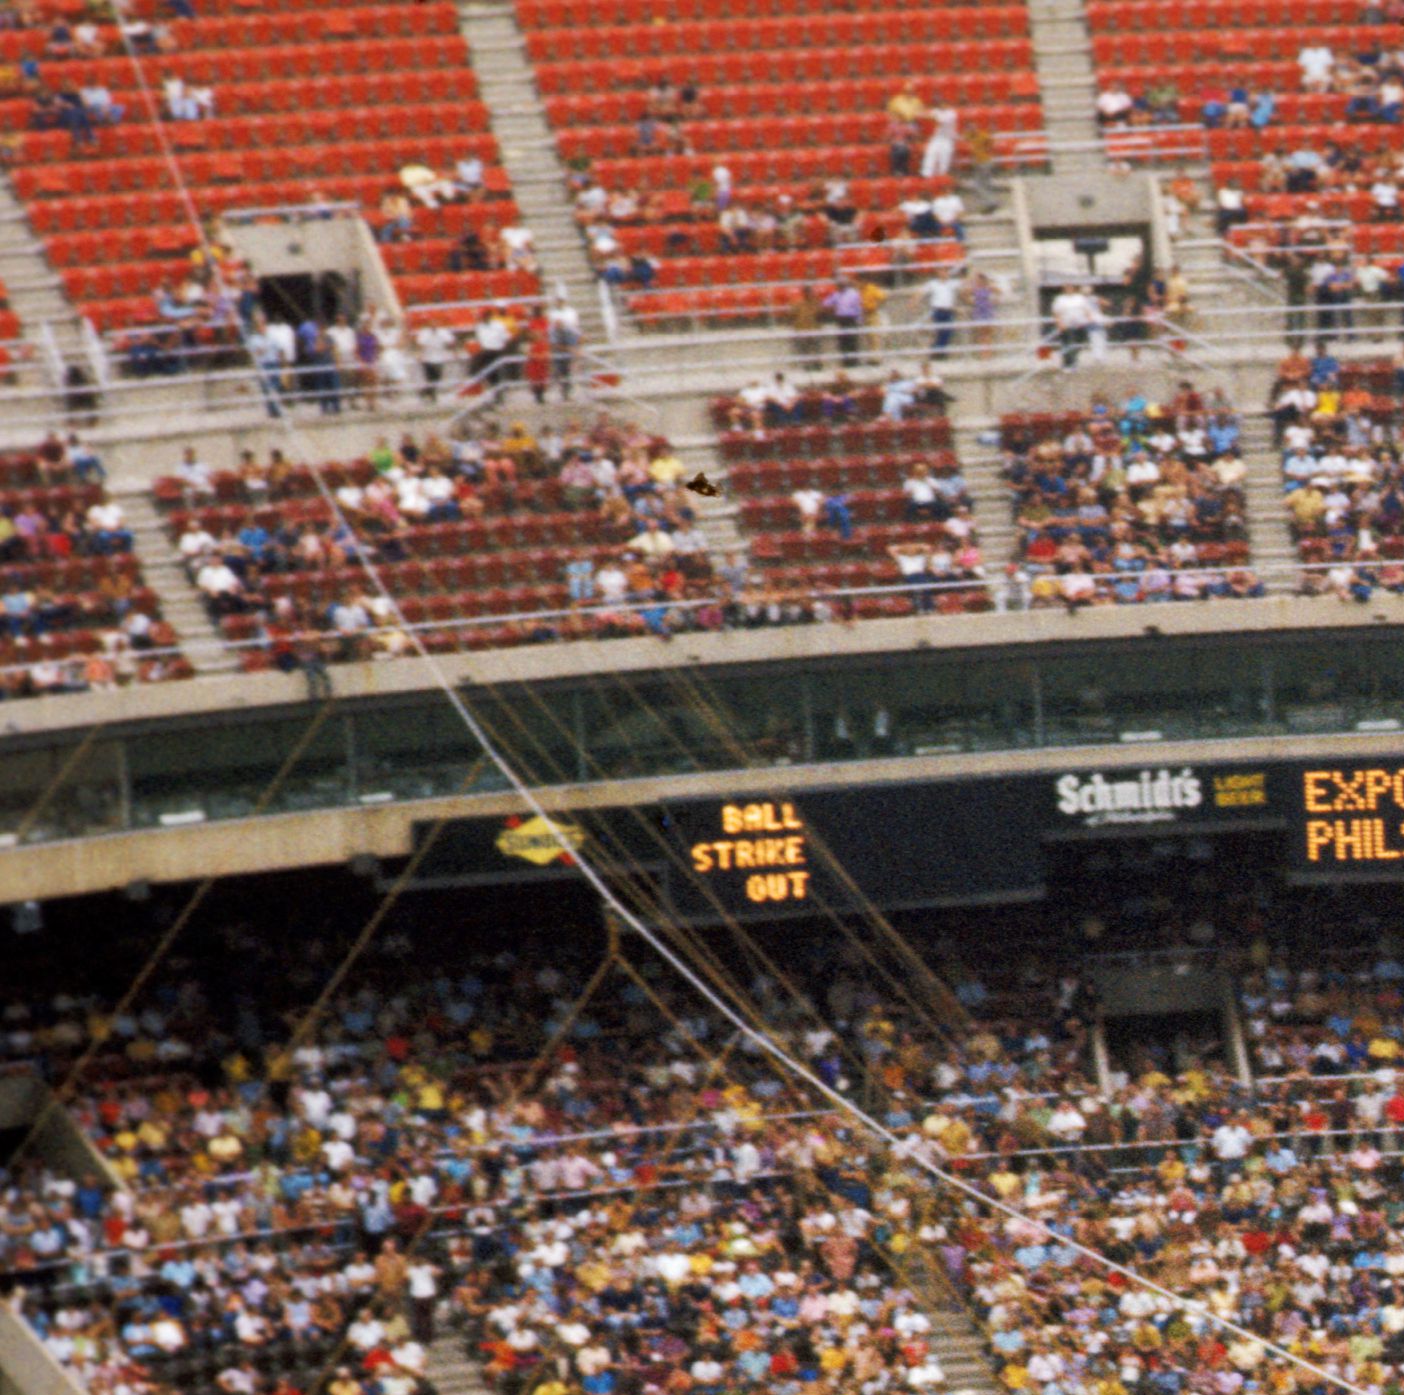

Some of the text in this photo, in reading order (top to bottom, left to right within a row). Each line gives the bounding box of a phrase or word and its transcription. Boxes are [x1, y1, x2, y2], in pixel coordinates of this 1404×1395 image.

[1056, 768, 1202, 814] Schmidt's
[722, 803, 802, 833] BALL
[691, 836, 805, 872] STRIKE
[746, 872, 809, 901] OUT
